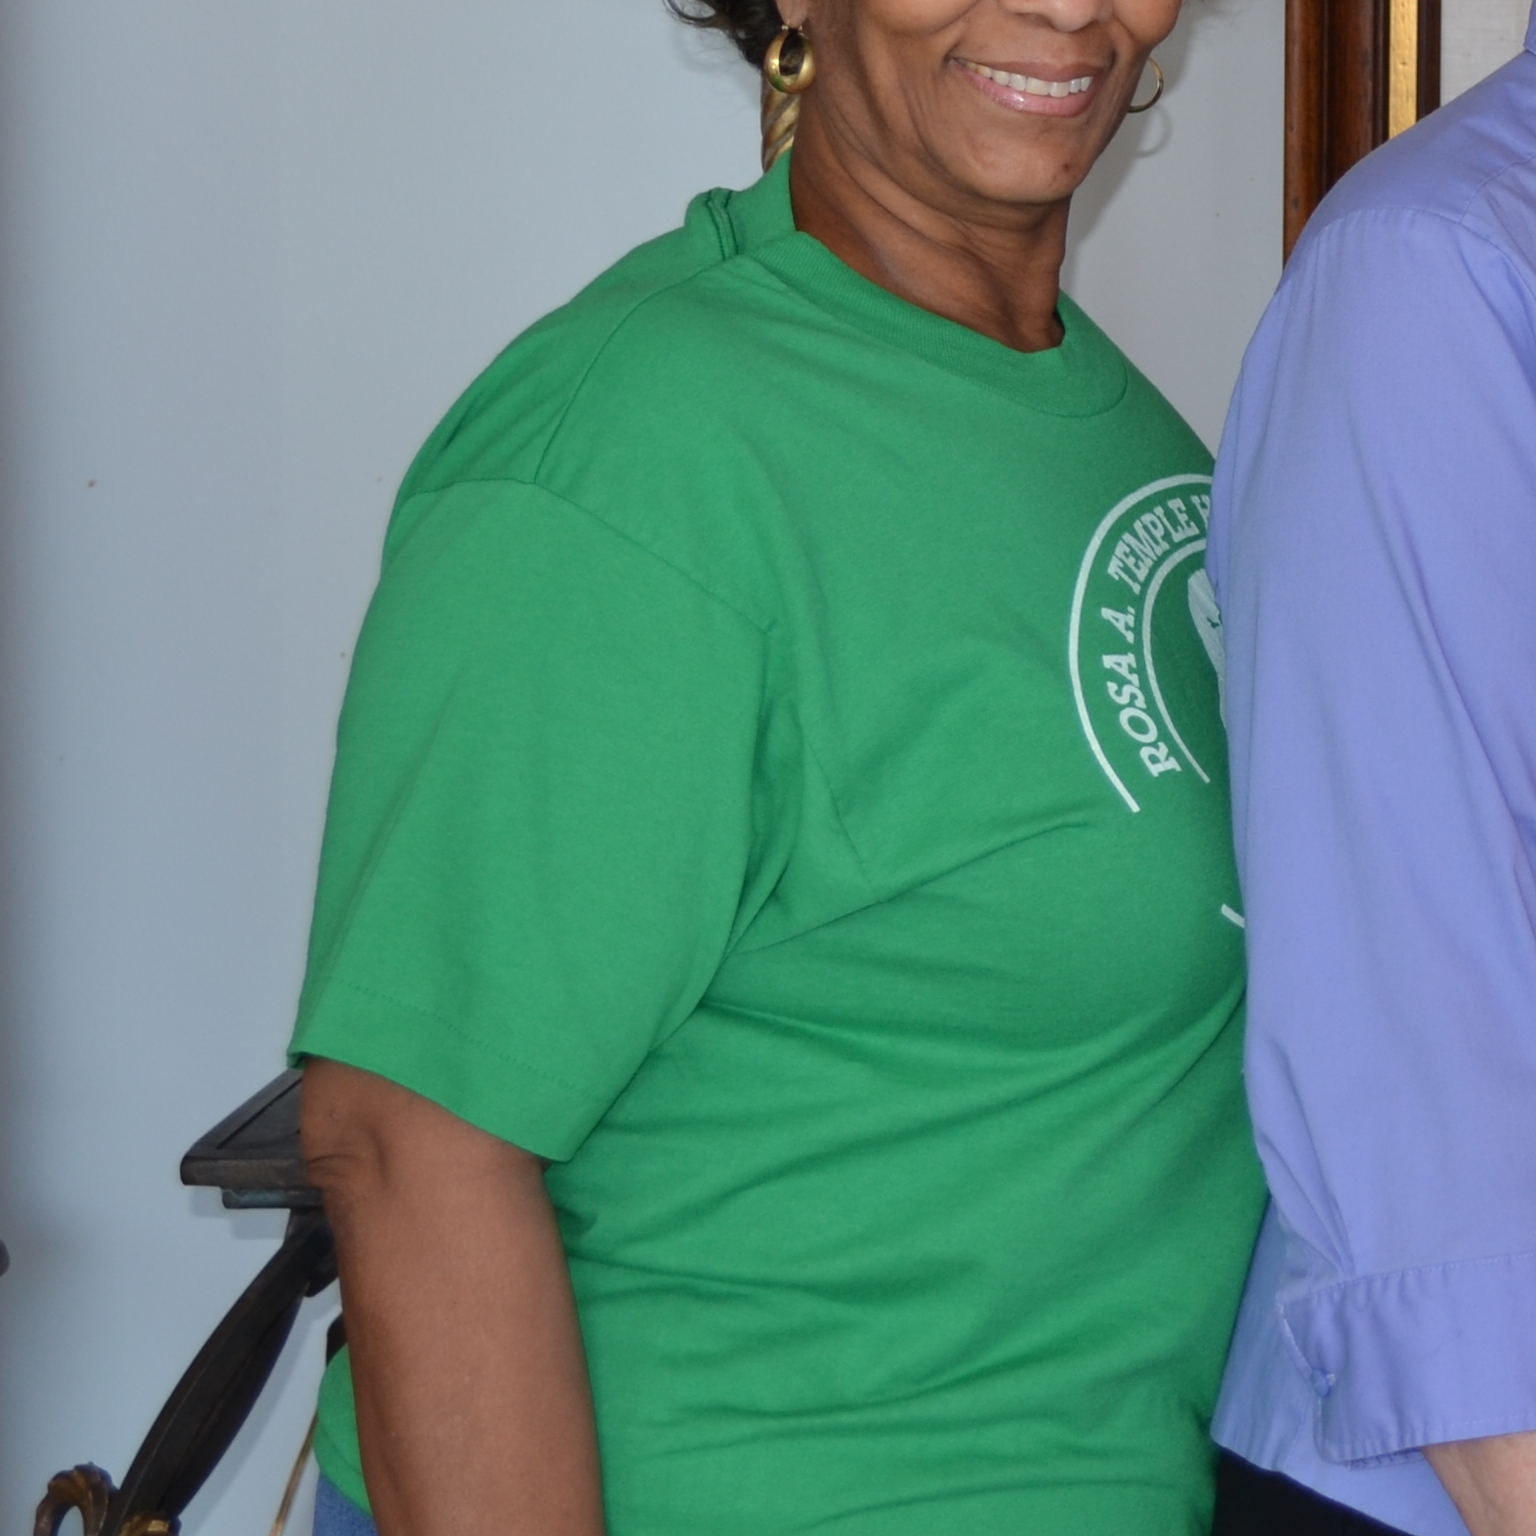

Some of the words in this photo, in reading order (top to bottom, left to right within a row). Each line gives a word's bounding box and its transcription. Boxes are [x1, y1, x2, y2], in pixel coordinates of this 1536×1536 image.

[1107, 497, 1200, 595] TEMPLE
[1101, 605, 1136, 644] A.
[1102, 653, 1182, 778] ROSA
